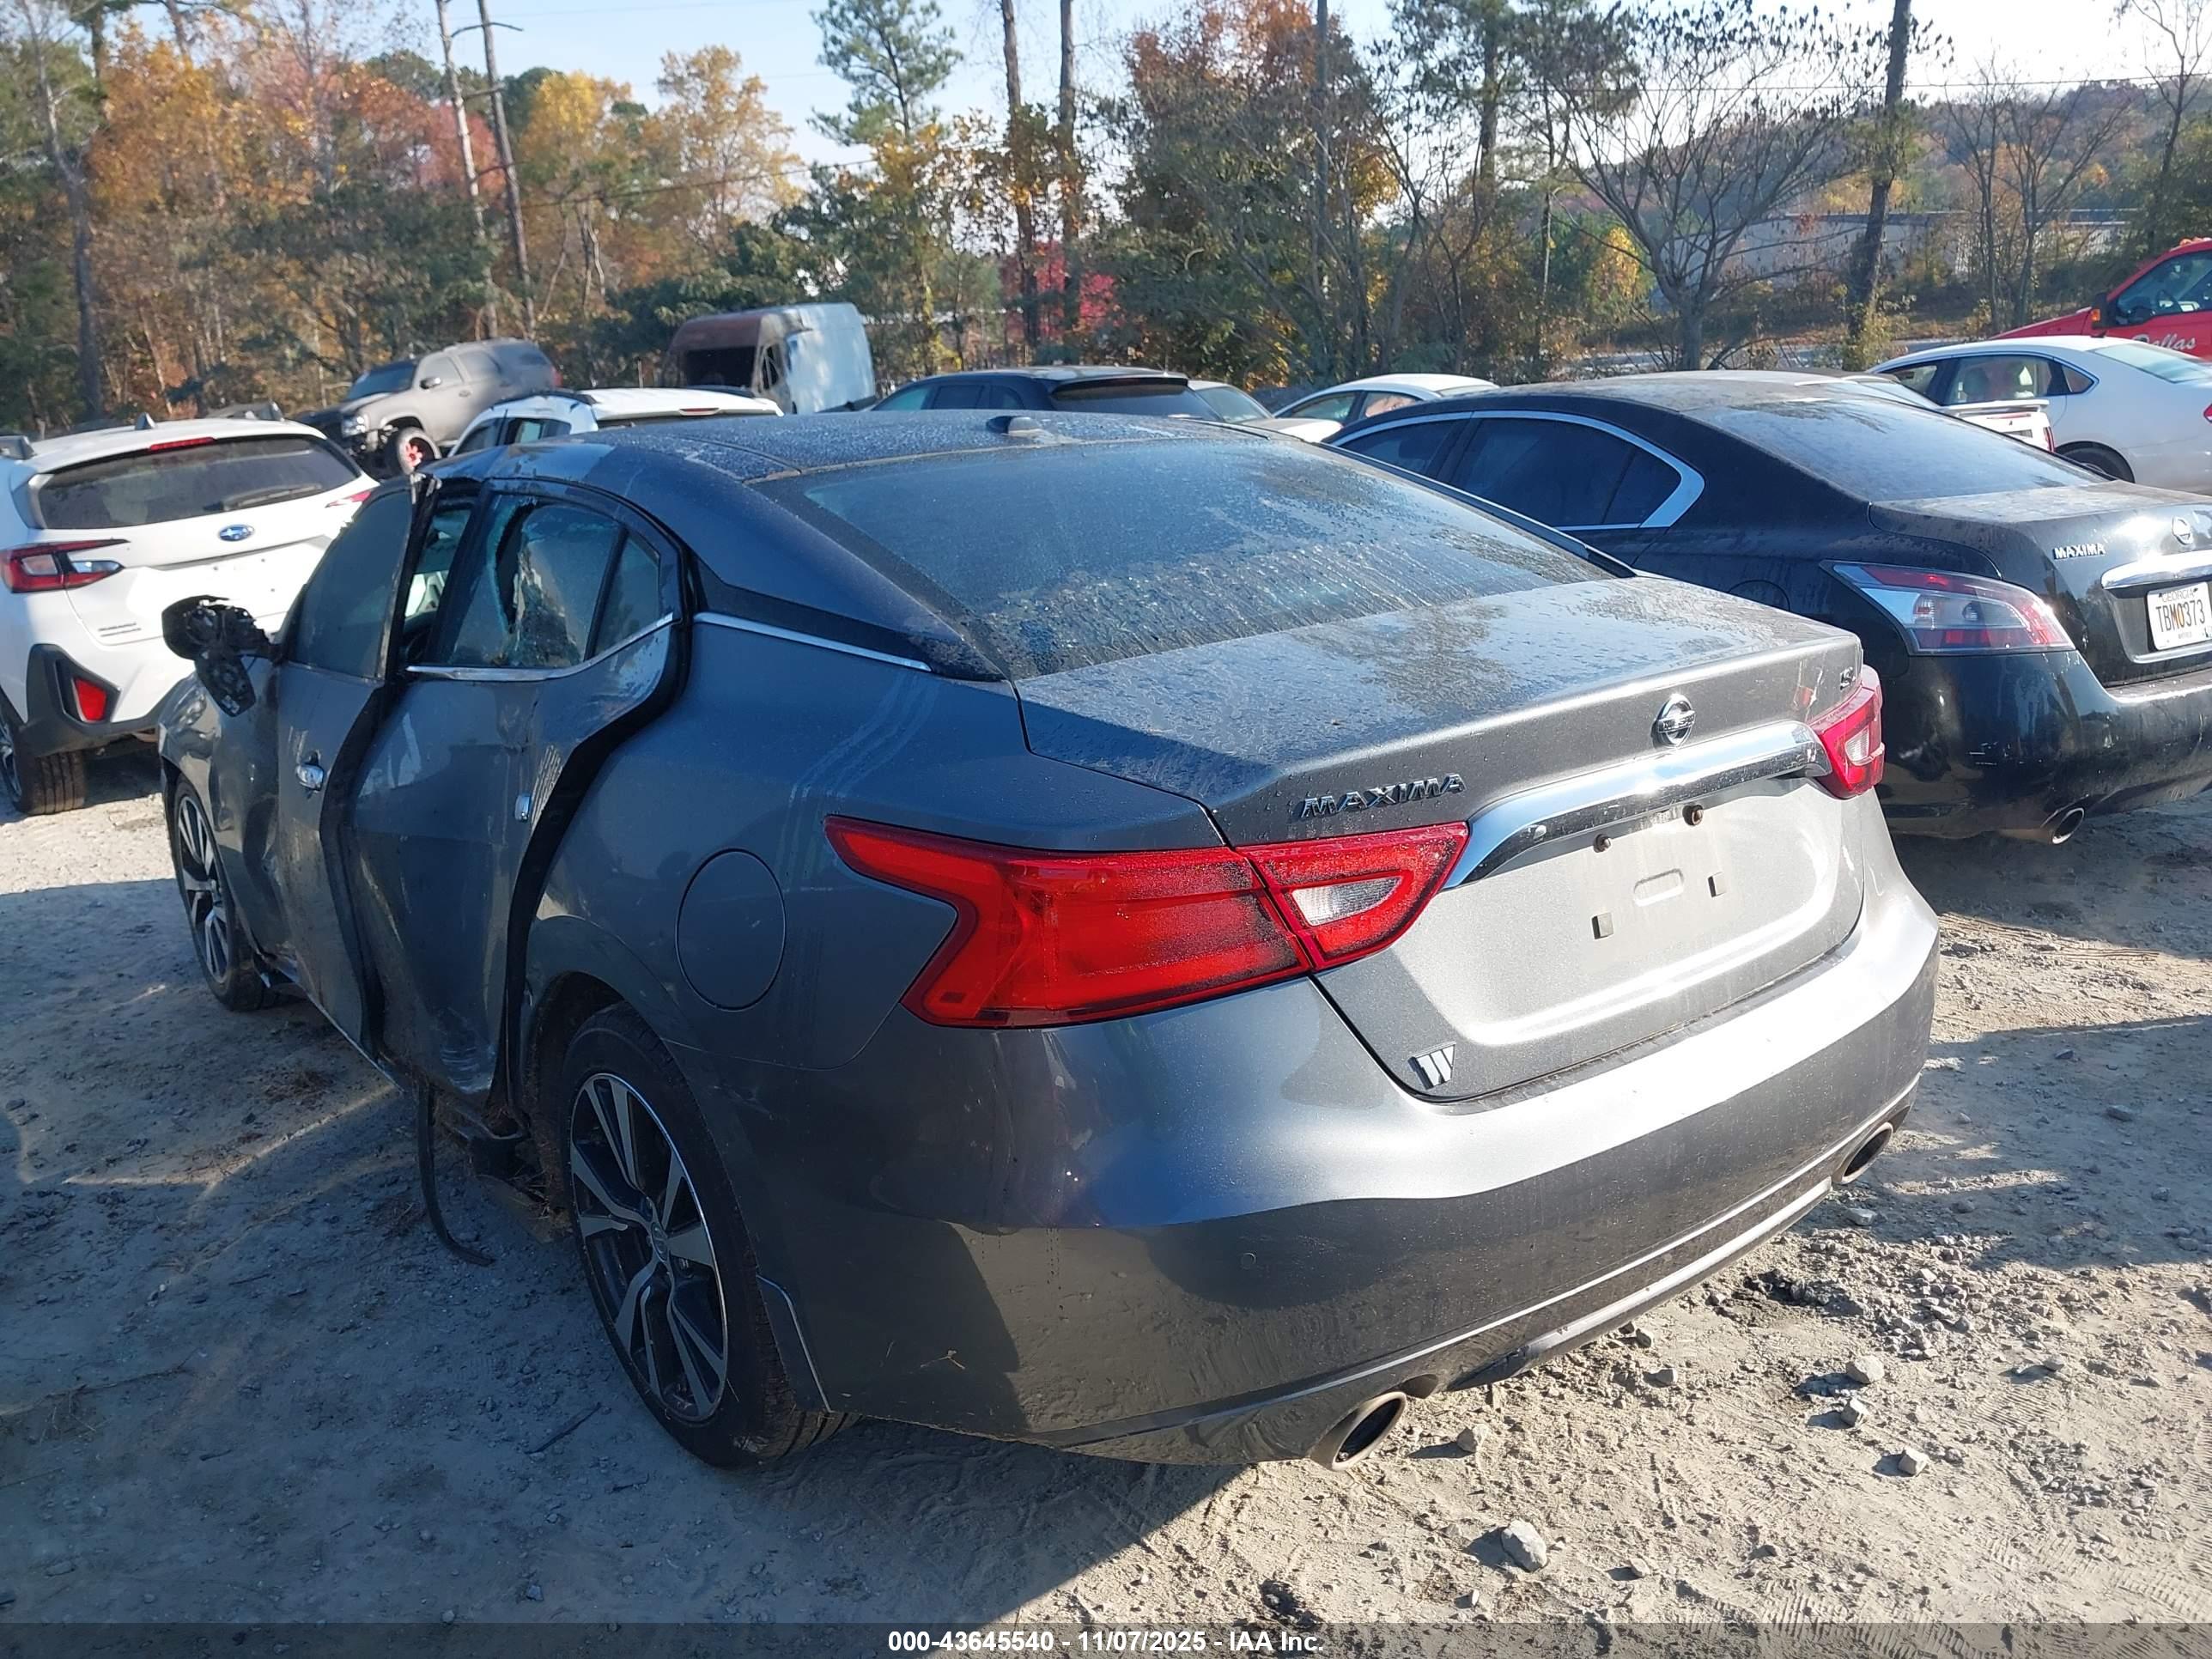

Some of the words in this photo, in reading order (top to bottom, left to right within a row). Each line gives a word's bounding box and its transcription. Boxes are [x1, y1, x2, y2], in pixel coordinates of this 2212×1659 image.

[2053, 543, 2106, 559] MAXIMA
[2155, 599, 2206, 633] TBM0373
[1300, 773, 1468, 818] MAXIMA
